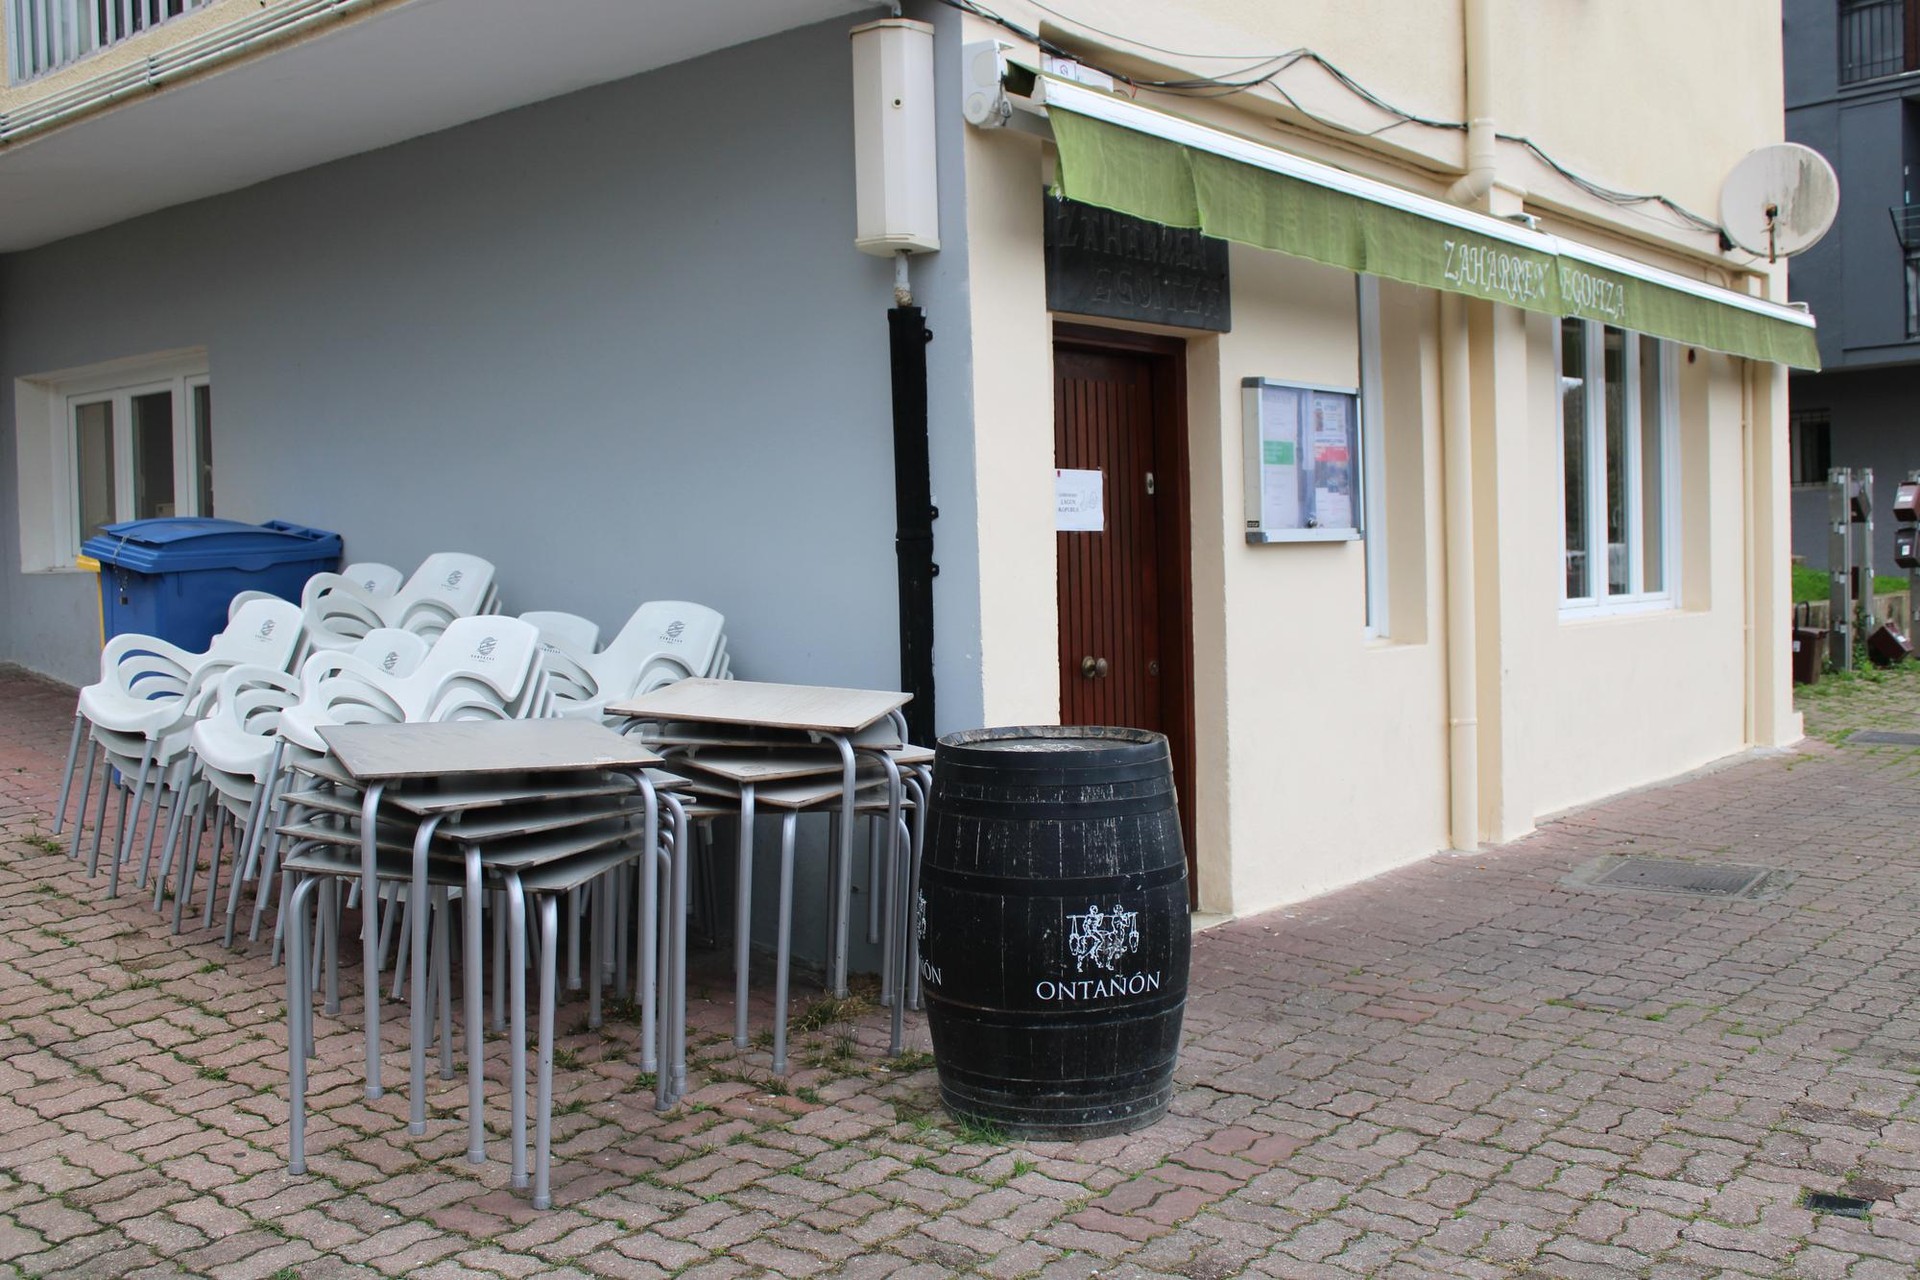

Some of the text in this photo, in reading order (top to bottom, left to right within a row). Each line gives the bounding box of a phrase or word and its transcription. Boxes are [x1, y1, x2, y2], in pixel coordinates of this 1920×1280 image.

[1444, 240, 1626, 319] ZAHARREN EGOITZA
[1036, 971, 1161, 1001] ONTAÑÓN
